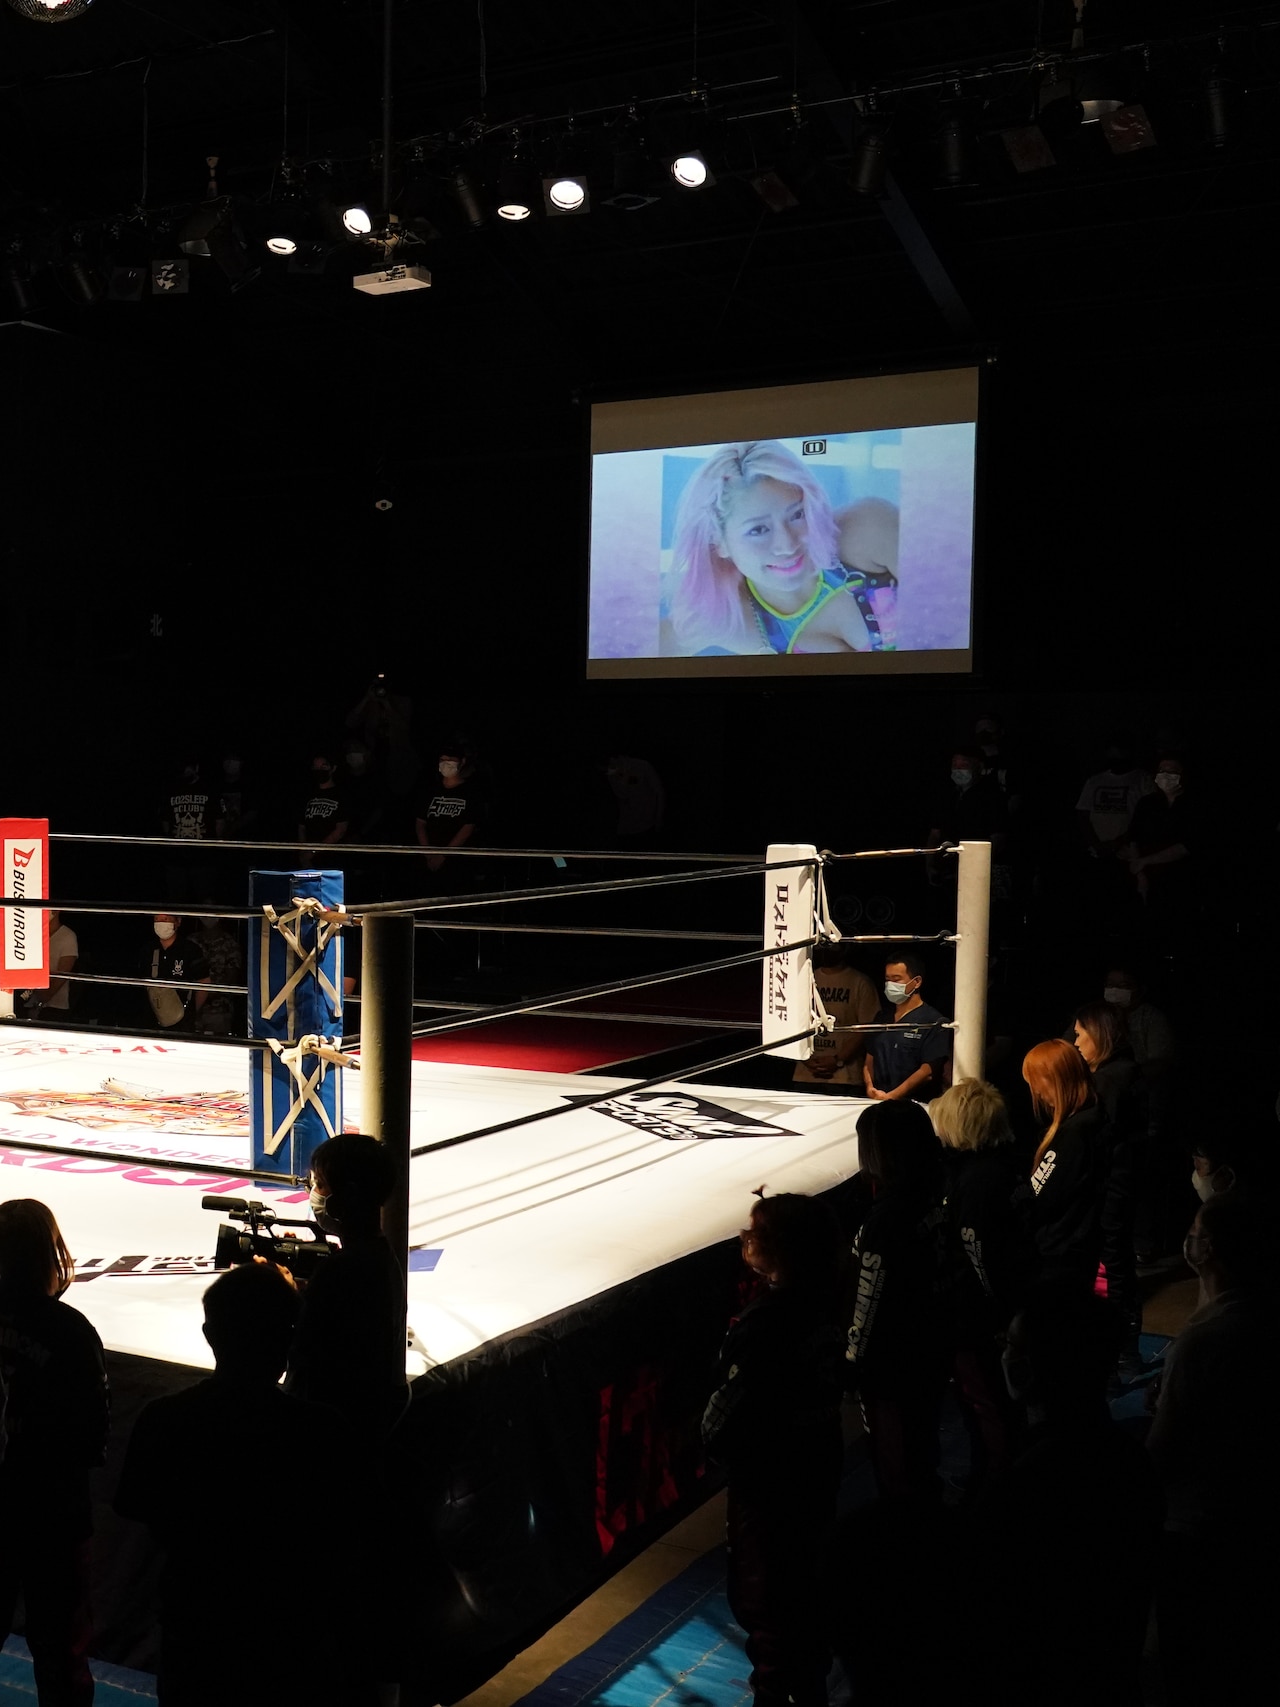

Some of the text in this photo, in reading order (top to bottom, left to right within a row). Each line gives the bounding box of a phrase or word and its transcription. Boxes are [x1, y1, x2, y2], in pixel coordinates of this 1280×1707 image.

[179, 804, 200, 813] CLUB
[819, 987, 851, 1003] SCARA
[814, 1039, 836, 1048] ELLERA
[845, 1250, 882, 1363] STARDOM
